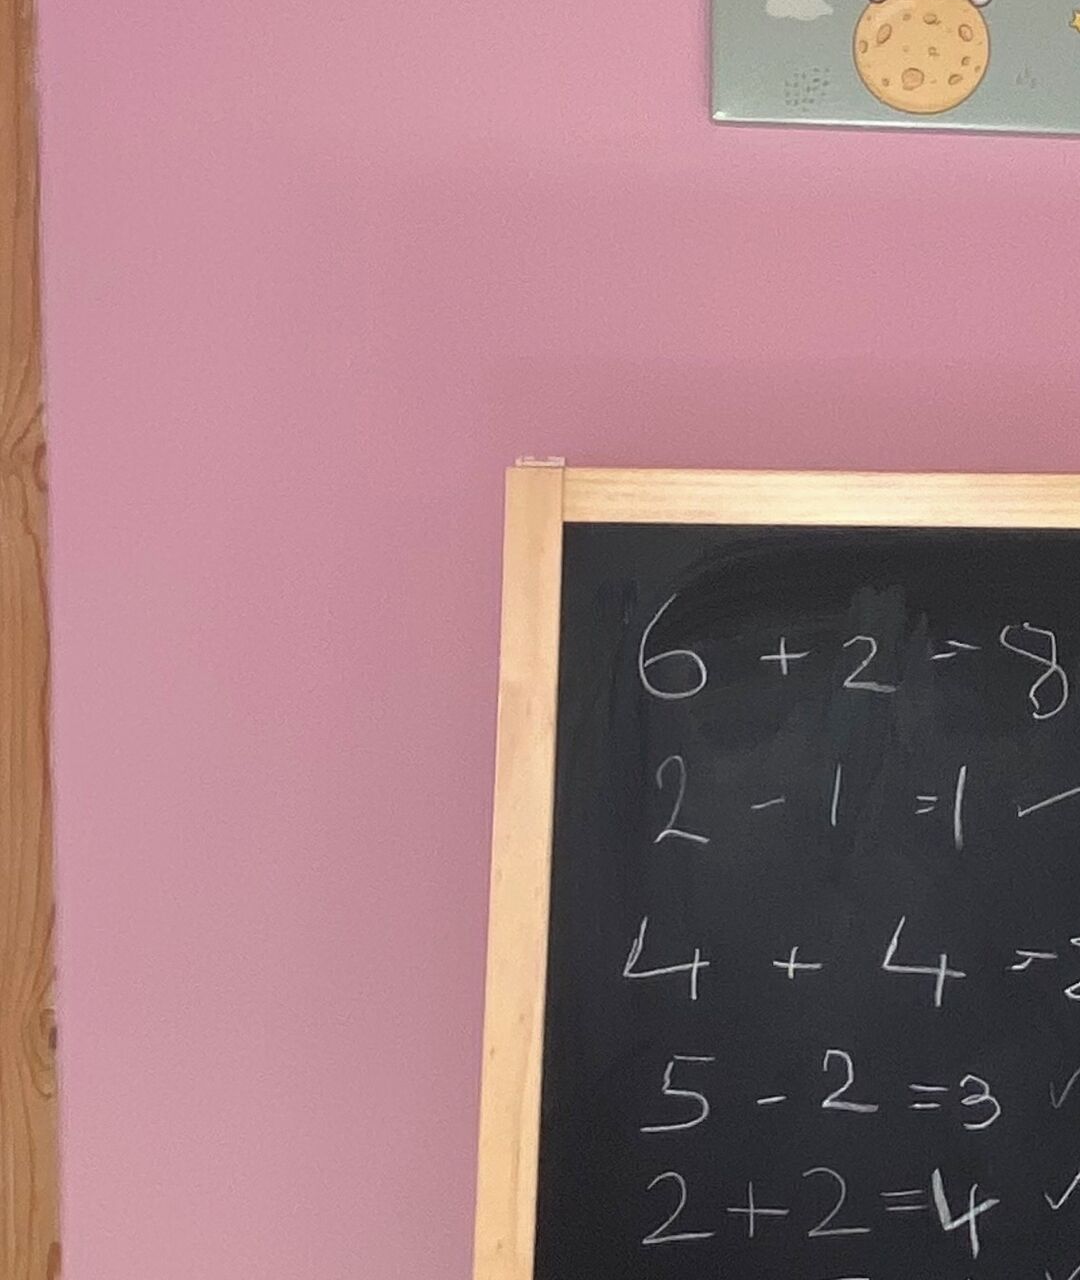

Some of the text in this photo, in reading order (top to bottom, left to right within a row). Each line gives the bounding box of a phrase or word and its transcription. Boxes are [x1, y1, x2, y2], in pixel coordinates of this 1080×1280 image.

[637, 593, 707, 700] 6
[843, 635, 897, 694] 2
[653, 755, 710, 844] 2
[622, 915, 711, 1001] 4
[881, 915, 967, 1008] 4
[640, 1054, 717, 1134] 5
[821, 1049, 880, 1113] 2
